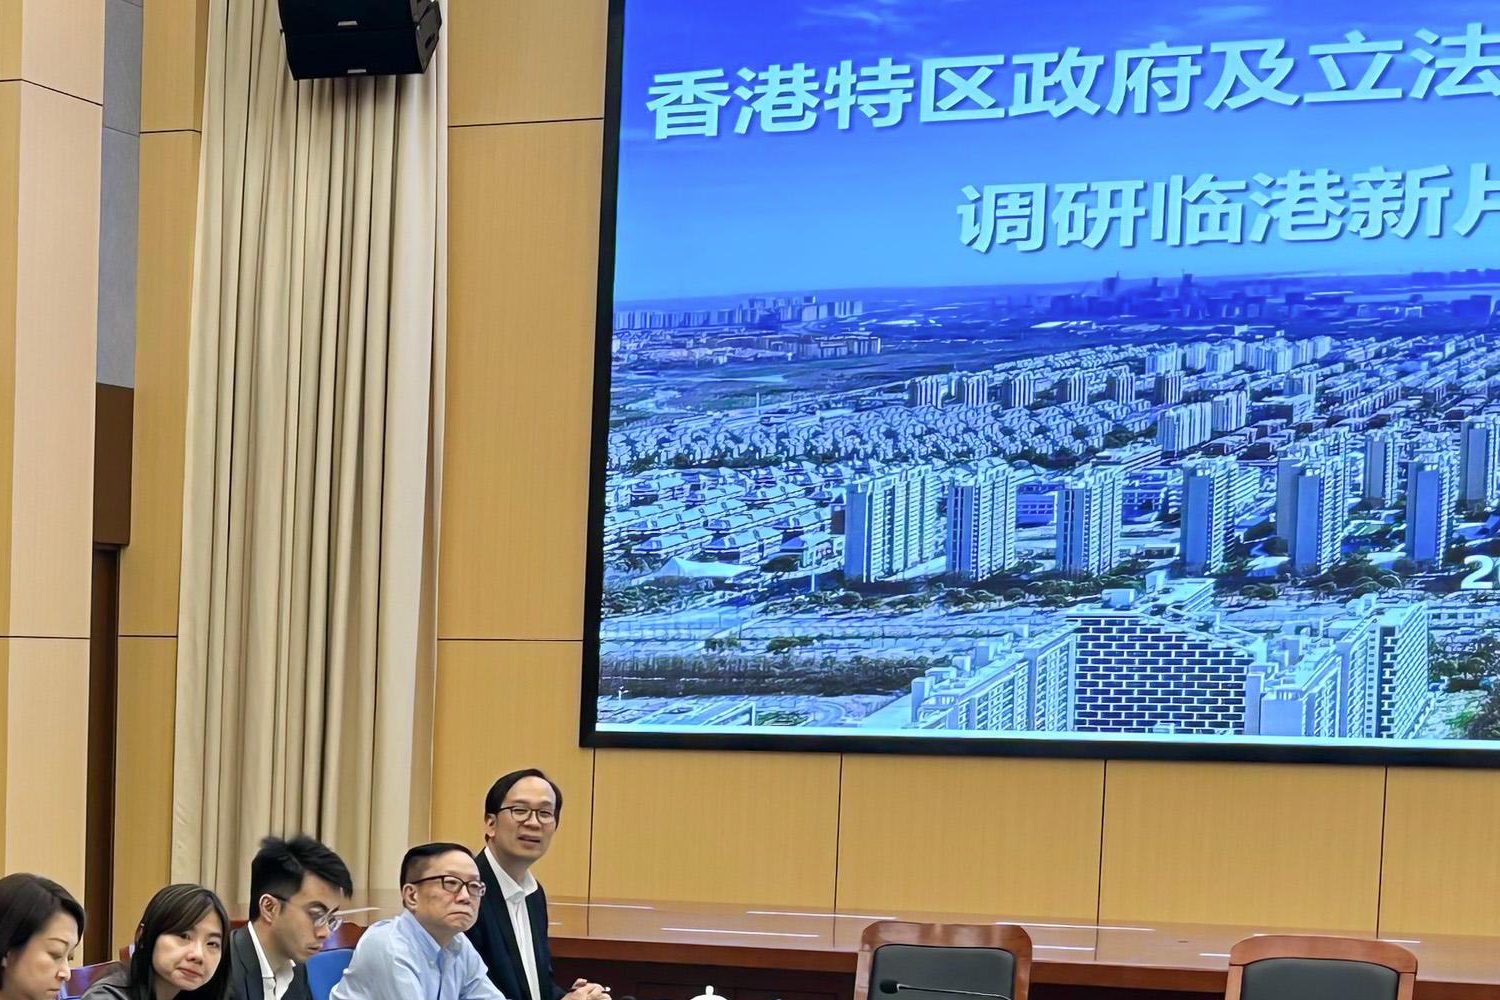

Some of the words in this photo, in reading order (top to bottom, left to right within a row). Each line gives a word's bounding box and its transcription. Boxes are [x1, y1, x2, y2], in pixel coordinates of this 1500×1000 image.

[646, 22, 1500, 140] 香港特区政府及立法
